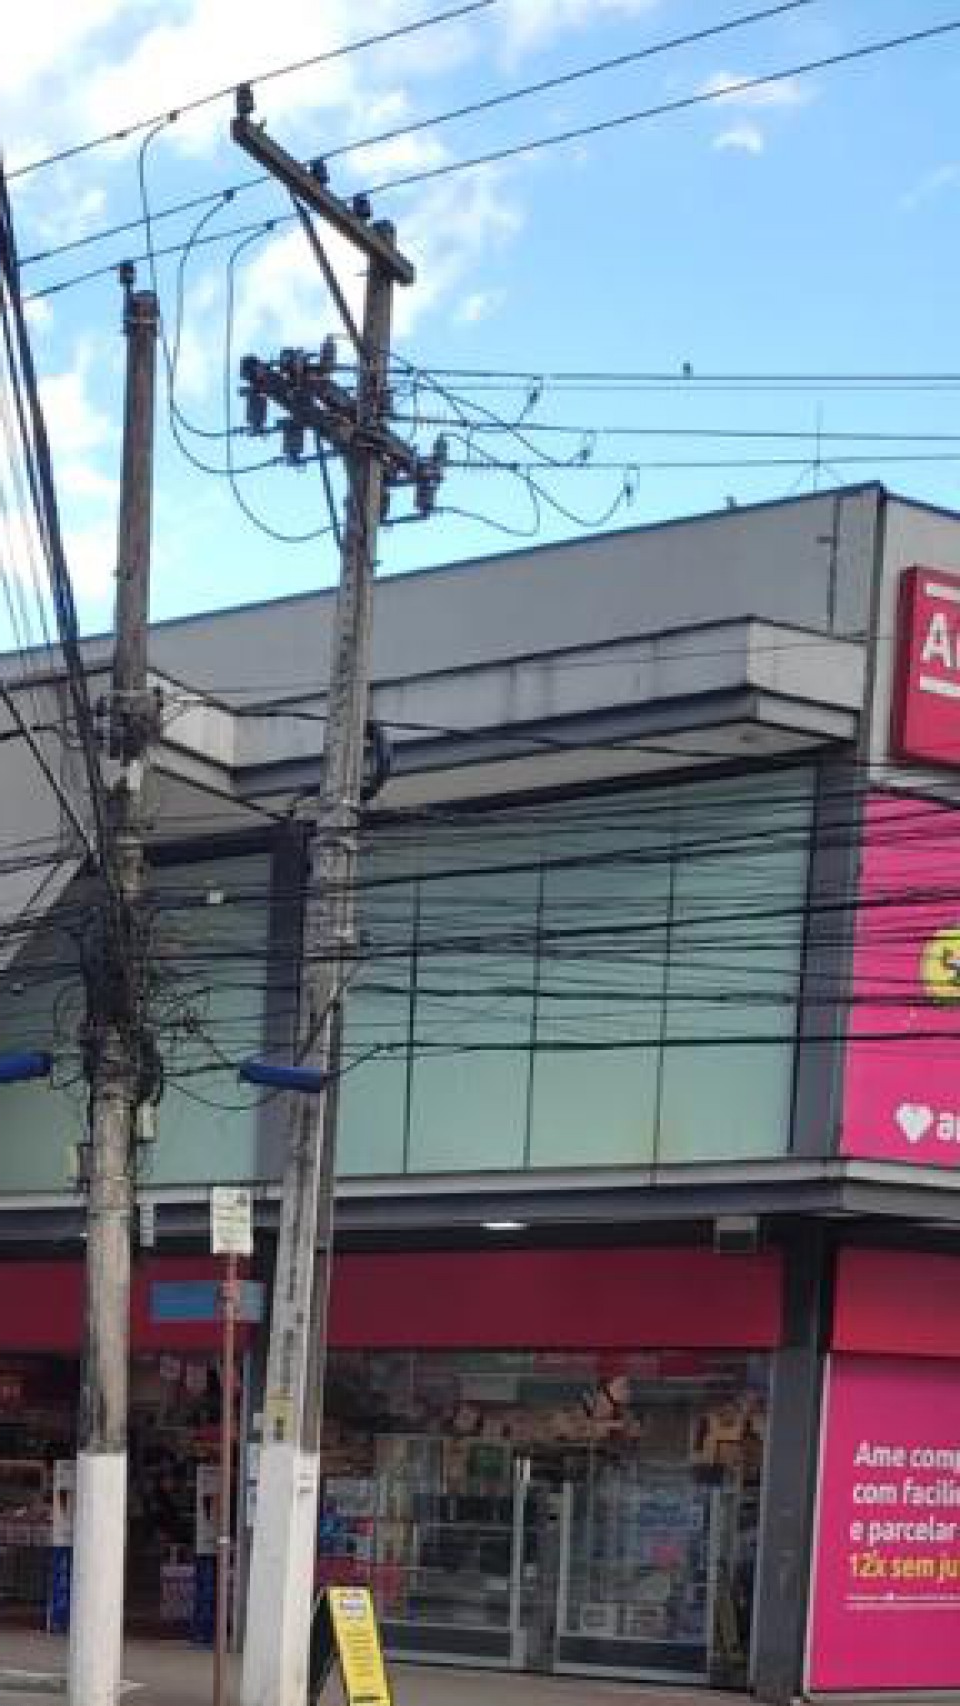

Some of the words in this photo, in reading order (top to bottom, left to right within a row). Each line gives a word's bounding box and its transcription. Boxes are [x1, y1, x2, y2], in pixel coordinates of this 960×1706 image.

[921, 611, 960, 669] A
[853, 1440, 905, 1468] Ame
[852, 1483, 897, 1505] com
[849, 1522, 864, 1542] e
[868, 1515, 957, 1547] parcelar
[850, 1551, 886, 1577] 12x
[889, 1558, 934, 1577] sem
